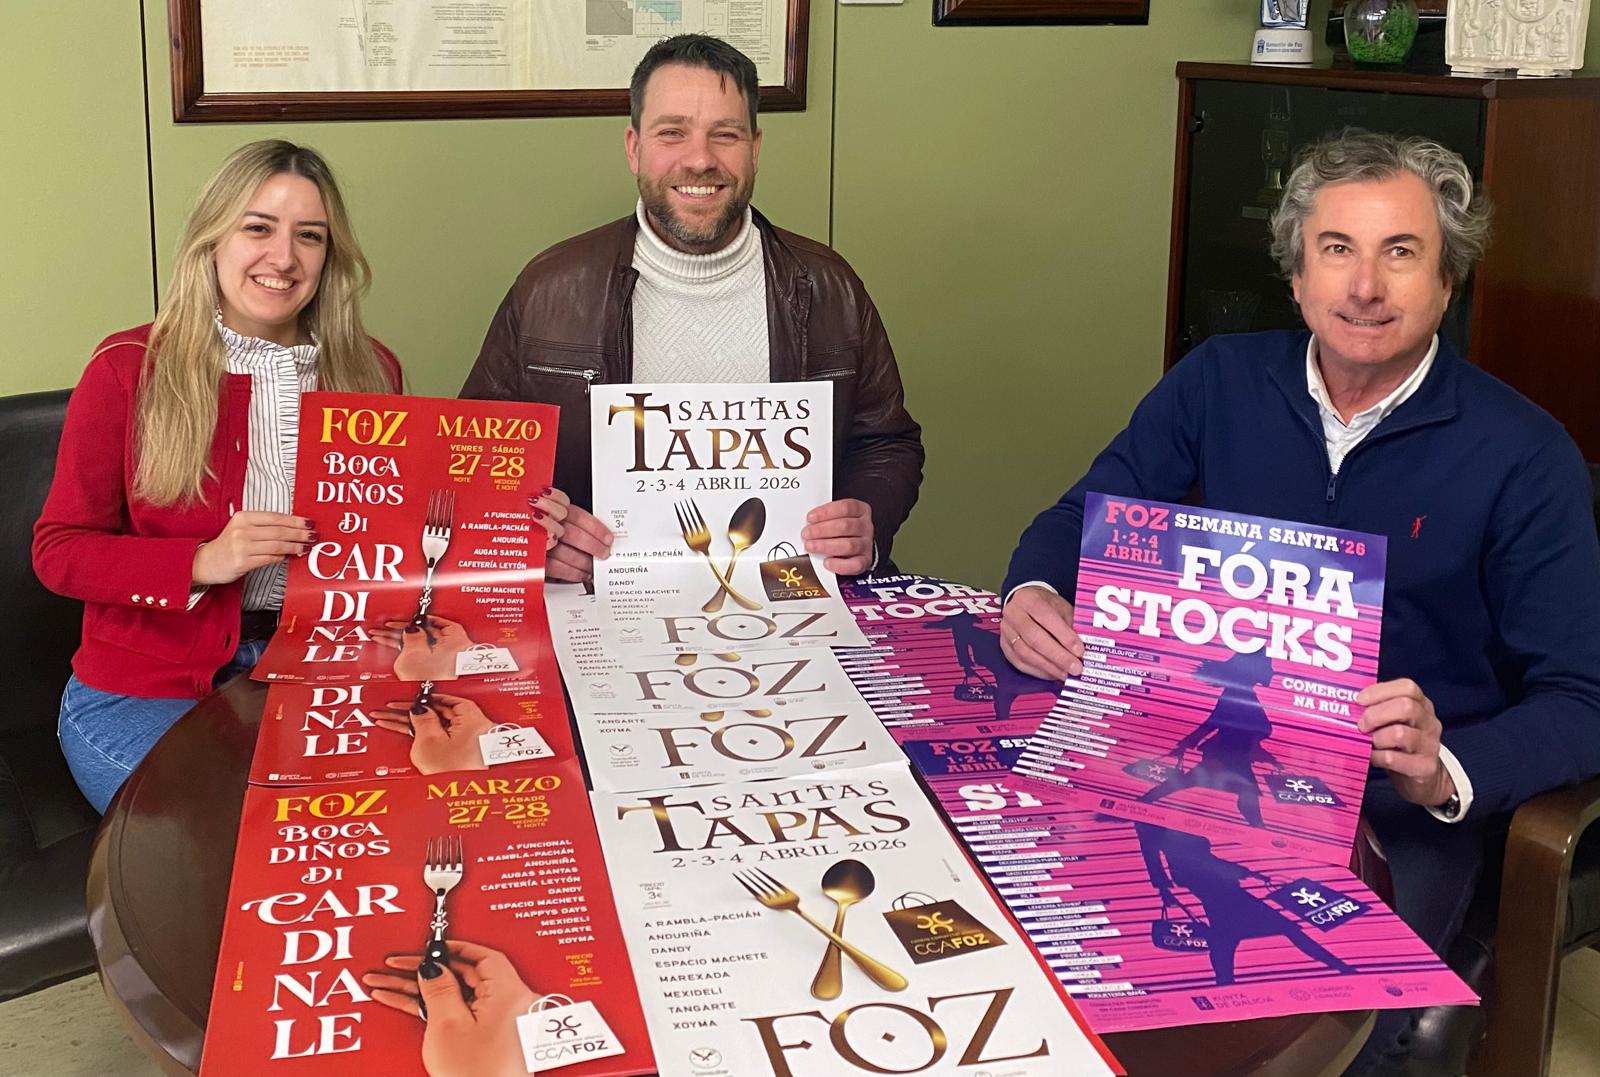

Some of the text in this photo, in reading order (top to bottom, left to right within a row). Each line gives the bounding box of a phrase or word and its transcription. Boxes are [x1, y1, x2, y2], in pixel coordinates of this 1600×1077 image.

[678, 396, 811, 422] SANTAS
[321, 407, 408, 446] FOZ
[437, 415, 541, 440] MARZO
[608, 392, 811, 473] TAPAS
[451, 444, 525, 454] VENRES SÁBADO
[323, 452, 400, 479] BOCA
[316, 478, 404, 504] DIÑOS
[695, 477, 752, 490] ABRIL
[760, 477, 801, 490] 2026
[469, 523, 530, 531] RAMBLA-PACHÁN
[1104, 500, 1170, 531] FOZ
[1174, 512, 1263, 540] SEMANA
[492, 536, 528, 545] ANDURIÑA
[308, 541, 404, 583] CAR
[474, 548, 528, 557] AUGAS SANTAS
[1103, 543, 1163, 566] ABRIL
[458, 559, 527, 569] CAFETERÍA LEYTÓN
[608, 565, 649, 574] ANDURIÑA
[1177, 541, 1359, 619] FÓRA
[772, 590, 821, 599] CCAFOZ
[319, 589, 369, 623] DI
[305, 625, 372, 643] NA
[655, 612, 838, 645] FOZ
[1092, 584, 1353, 672] STOCKS
[301, 644, 362, 663] LE
[625, 658, 826, 701] FOZ
[309, 685, 365, 708] DI
[1293, 695, 1350, 716] NA RÚA
[300, 708, 376, 731] NA
[303, 732, 369, 757] LE
[648, 714, 867, 768] FOZ
[929, 740, 998, 755] FOZ
[946, 762, 1009, 773] ABRIL
[426, 775, 561, 799] MARZO
[711, 781, 889, 811] SANTAS
[273, 789, 387, 822] FOZ
[447, 795, 545, 807] VENRES SÁBADO
[278, 821, 384, 842] BOCA
[617, 795, 910, 853] TAPAS
[269, 839, 391, 863] DIÑOS
[487, 848, 574, 862] RAMBLA-PACHÁN
[517, 840, 572, 850] FUNCIONAL
[759, 844, 838, 862] ABRIL
[848, 839, 907, 853] 2026
[501, 867, 578, 879] AUGAS SANTAS
[524, 857, 576, 868] ANDURIÑA
[480, 876, 580, 891] CAFETERÍA LEYTÓN
[548, 886, 583, 895] DANDY
[241, 885, 405, 925] CAR
[490, 896, 585, 911] ESPACIO MACHETE
[515, 906, 588, 919] HAPPYS DAYS
[1311, 900, 1360, 925] CCAFOZ
[541, 916, 590, 926] MEXIDELI
[656, 910, 761, 926] RAMBLA-PACHÁN
[536, 926, 592, 936] TANGARTE
[558, 935, 595, 945] XOYMA
[648, 929, 711, 941] ANDURIÑA
[280, 925, 353, 965] DI
[651, 945, 692, 955] DANDY
[914, 933, 989, 955] CCAFOZ
[655, 952, 768, 969] ESPACIO MACHETE
[659, 971, 731, 983] MAREXADA
[266, 968, 373, 1011] NA
[663, 988, 723, 998] MEXIDELI
[667, 1001, 737, 1013] TANGARTE
[672, 1020, 718, 1030] XOYMA
[739, 987, 1049, 1077] FOZ
[270, 1012, 362, 1060] LE
[534, 1040, 609, 1061] CCAFOZ
